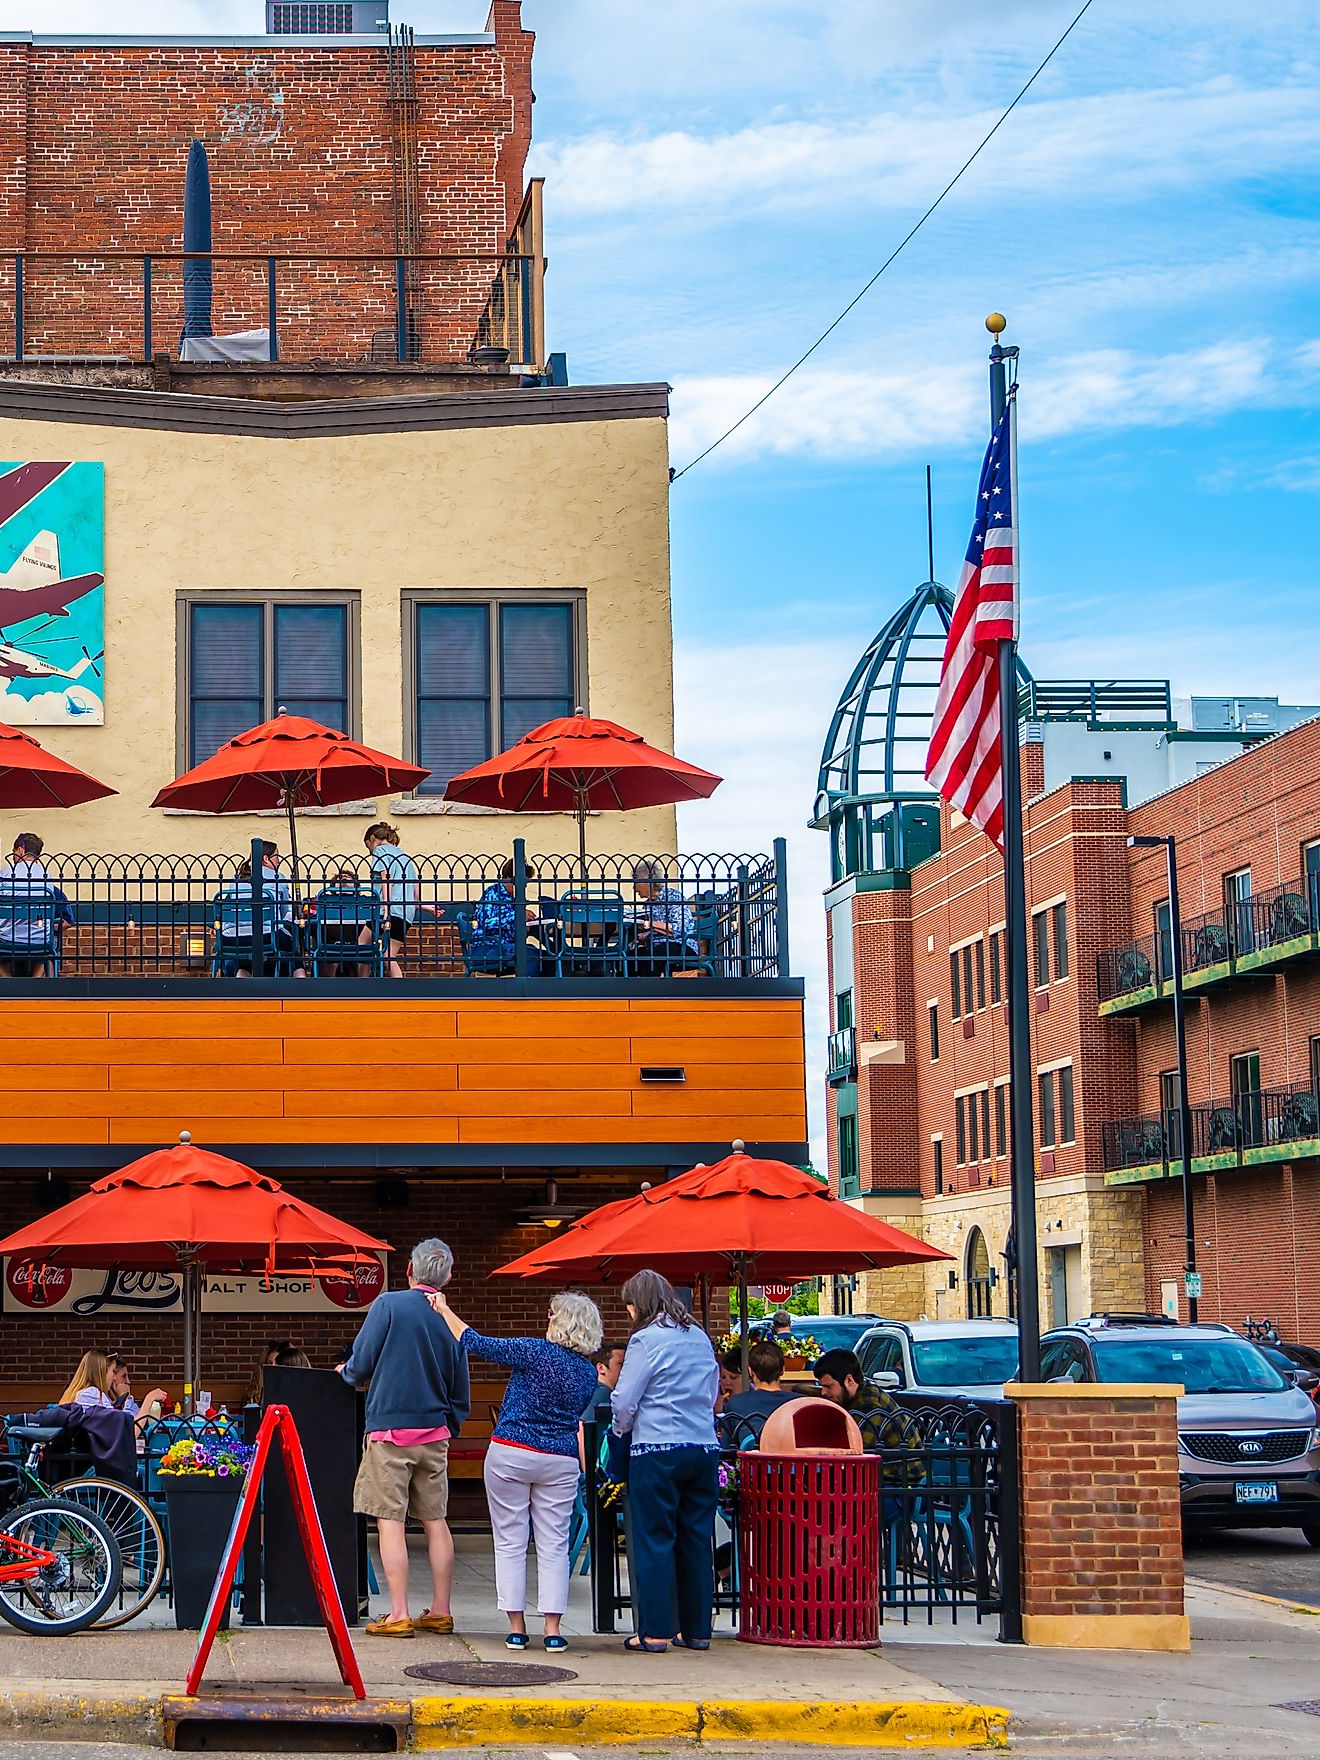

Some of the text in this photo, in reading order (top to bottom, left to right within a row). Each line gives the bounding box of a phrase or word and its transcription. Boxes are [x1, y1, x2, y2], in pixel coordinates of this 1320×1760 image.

[22, 556, 57, 571] FLYING VIKINGS
[39, 661, 59, 672] MARINES
[765, 1284, 790, 1295] STOP
[1242, 1443, 1259, 1451] KIA
